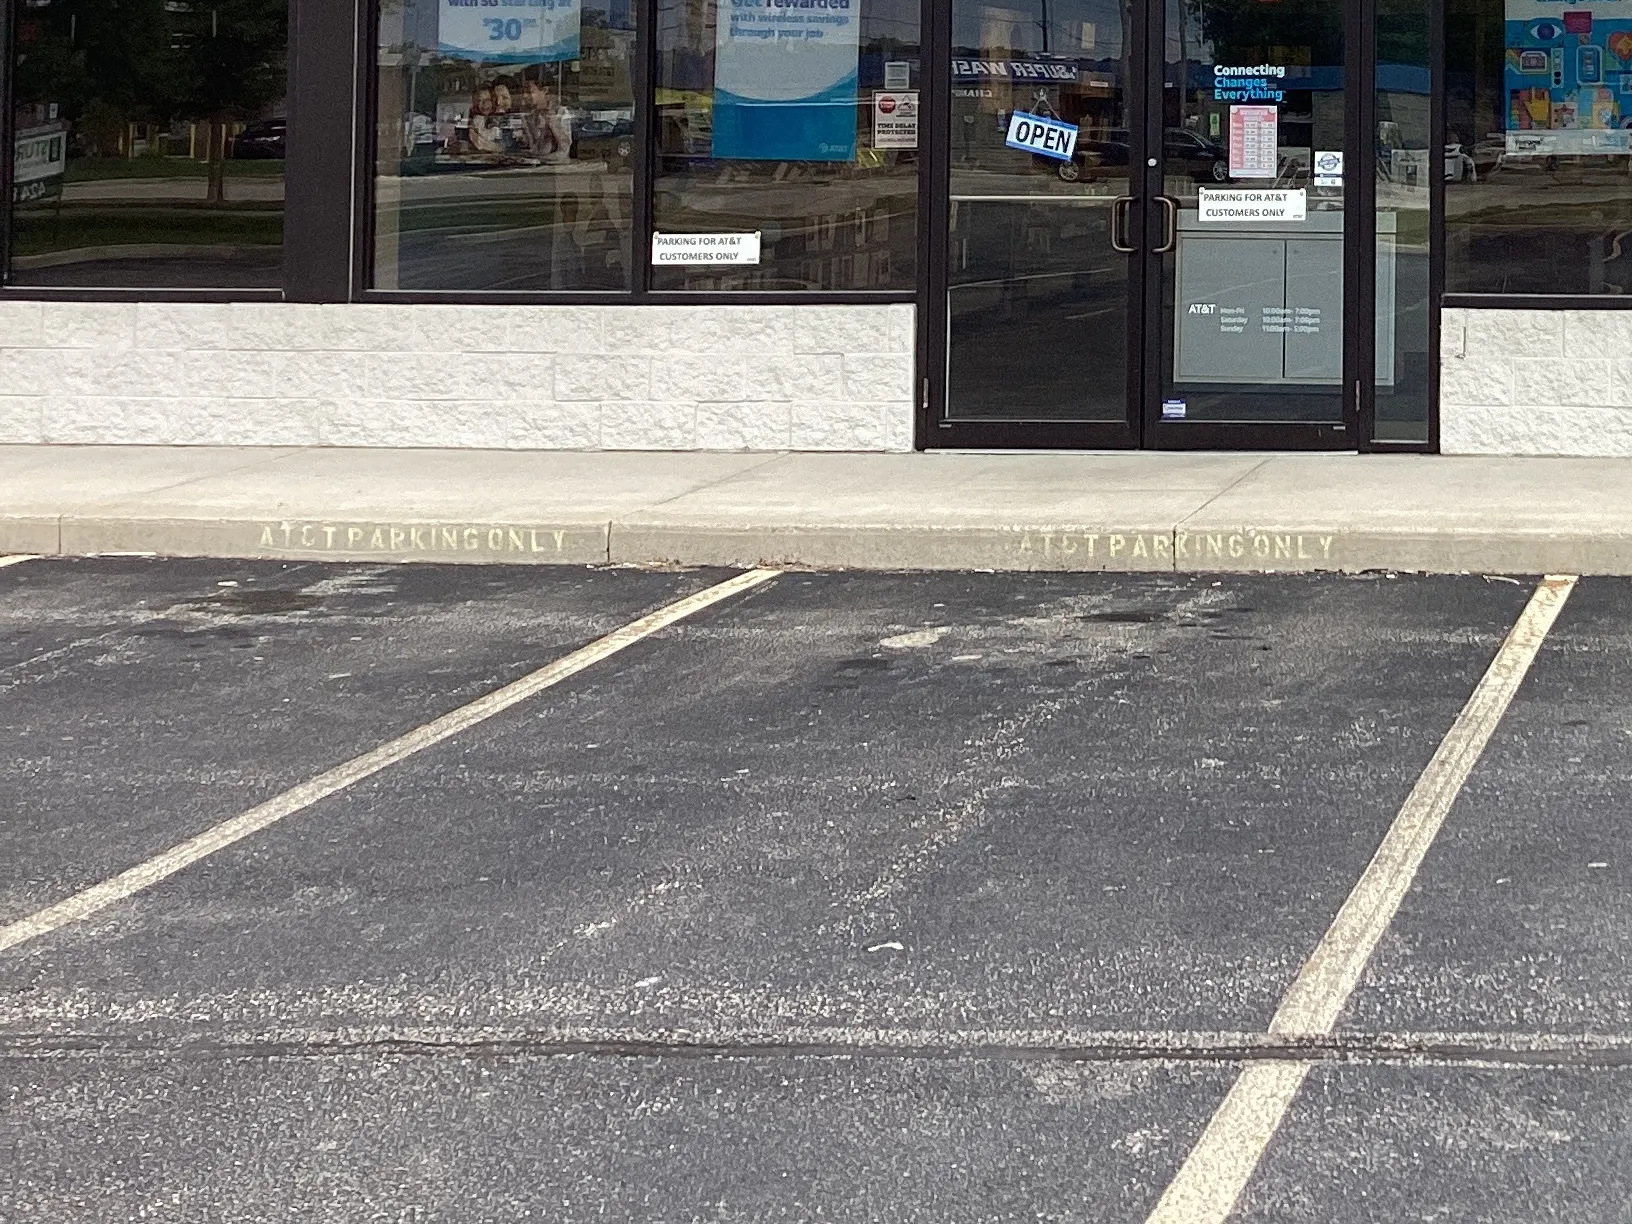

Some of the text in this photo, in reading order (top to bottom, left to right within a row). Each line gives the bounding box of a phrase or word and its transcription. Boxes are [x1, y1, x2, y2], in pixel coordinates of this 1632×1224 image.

[730, 12, 756, 23] with
[758, 11, 804, 23] wireless
[1213, 63, 1285, 78] Connecting
[1214, 76, 1267, 90] Changes
[1214, 87, 1284, 102] Everything
[1015, 120, 1071, 154] OPEN
[1206, 208, 1260, 217] CUSTOMERS
[1262, 208, 1285, 217] ONLY
[718, 237, 742, 245] AT&T
[659, 252, 714, 261] CUSTOMERS
[716, 252, 739, 261] ONLY
[1188, 303, 1216, 314] AT&T
[1220, 325, 1244, 333] Sunday
